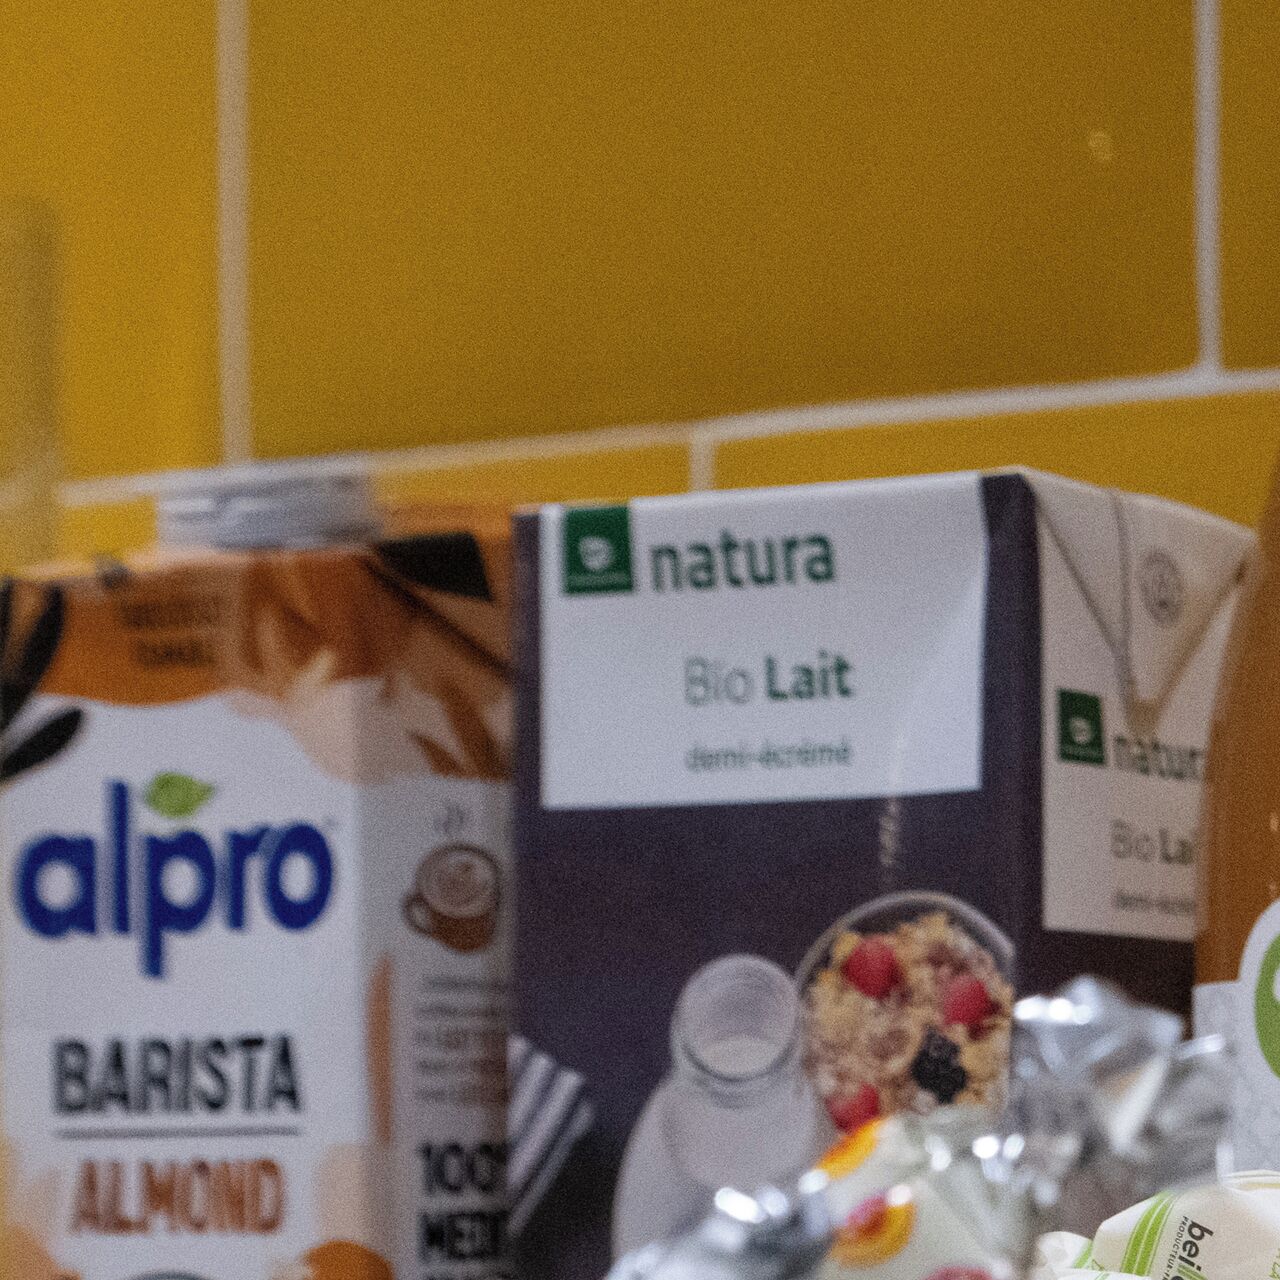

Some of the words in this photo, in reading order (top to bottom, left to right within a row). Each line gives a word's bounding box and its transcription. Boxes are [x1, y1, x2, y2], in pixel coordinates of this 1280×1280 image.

[650, 528, 837, 592] natura
[684, 656, 755, 705] Bio
[764, 650, 854, 701] Lait
[15, 777, 334, 979] alpro
[54, 1033, 302, 1116] BARISTA
[70, 1157, 285, 1236] ALMOND
